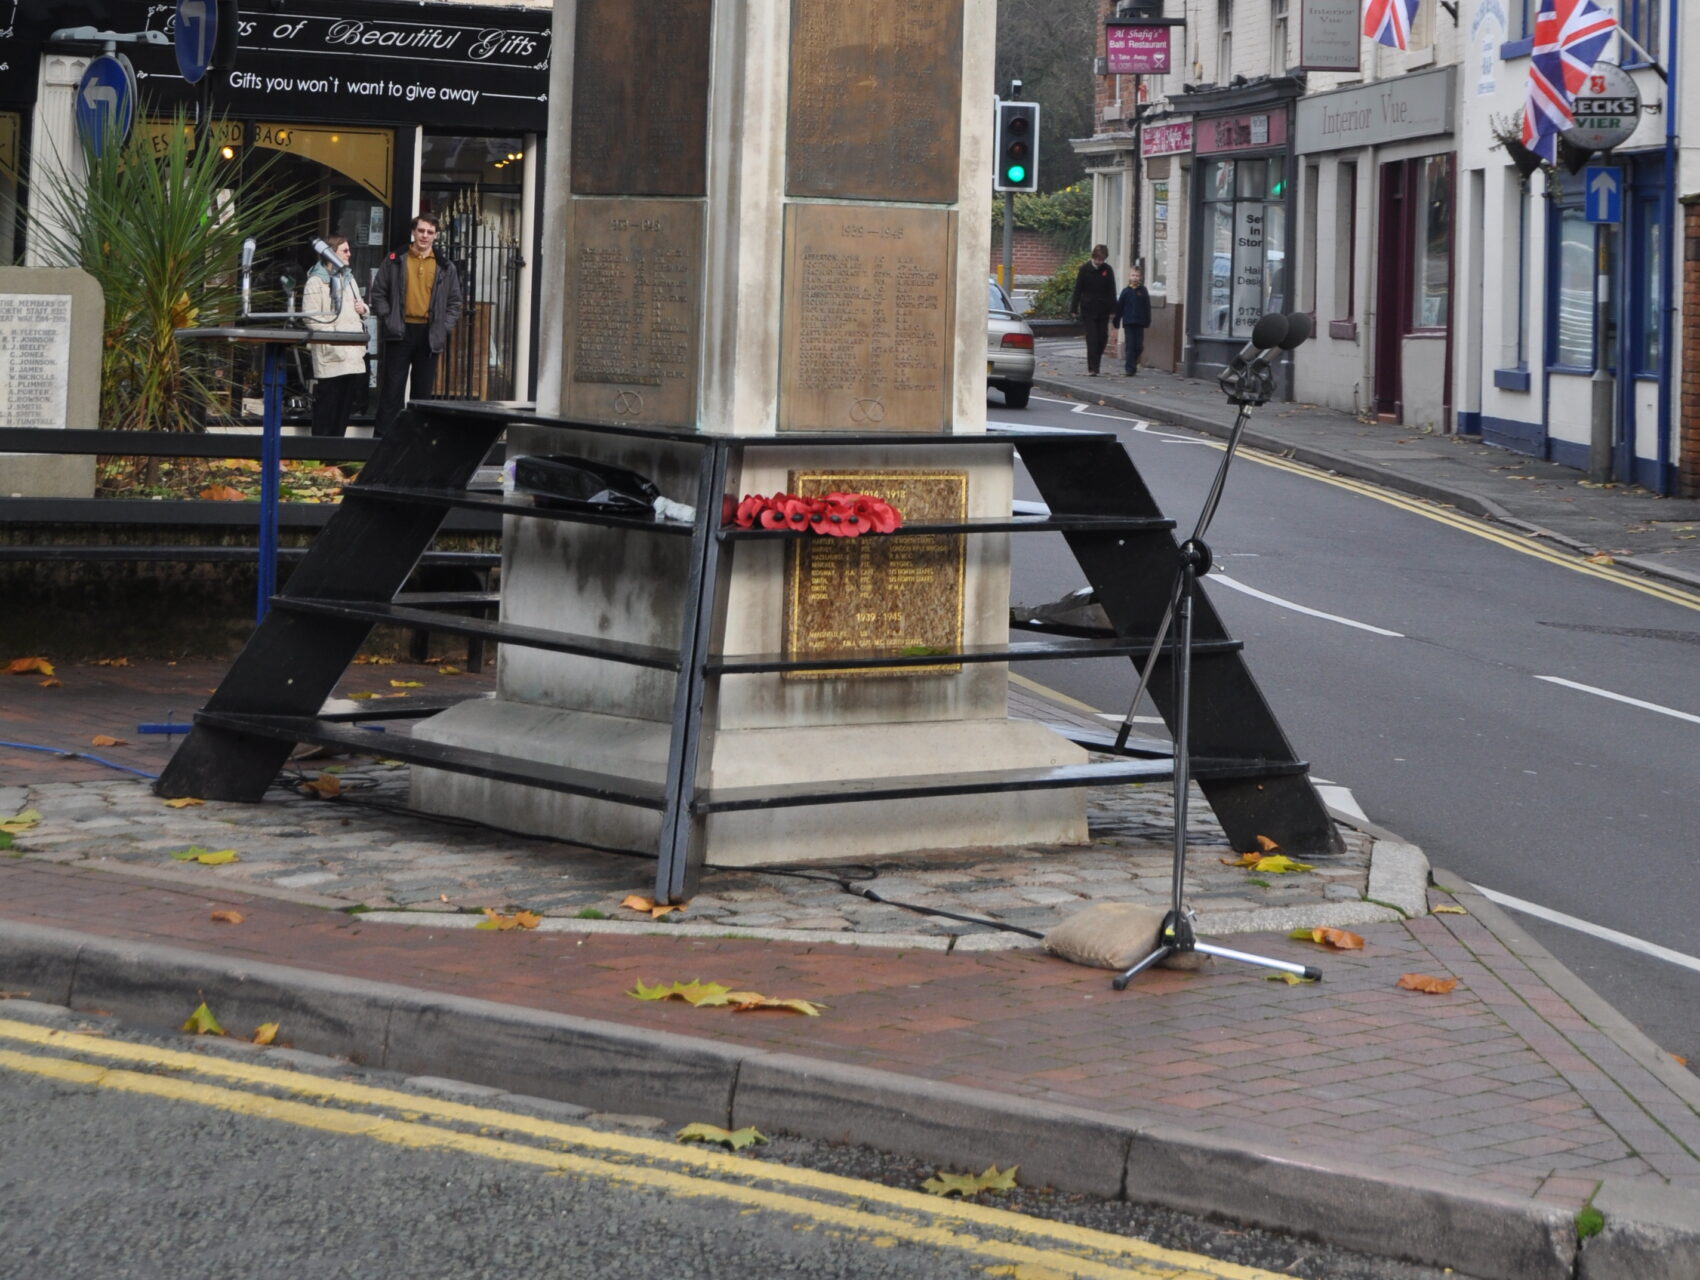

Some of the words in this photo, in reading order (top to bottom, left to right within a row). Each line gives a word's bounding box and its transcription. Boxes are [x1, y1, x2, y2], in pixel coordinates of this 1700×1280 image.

[273, 20, 308, 39] of
[325, 19, 462, 49] Beautiful
[468, 27, 537, 61] Gifts
[1128, 40, 1167, 49] Restaurant
[229, 71, 262, 90] Gifts
[266, 76, 293, 93] you
[347, 80, 384, 96] want
[388, 83, 403, 97] to
[406, 82, 436, 101] give
[439, 86, 479, 105] away
[1321, 100, 1372, 135] Interior
[1381, 93, 1408, 123] Vue
[1575, 117, 1622, 129] VIER
[254, 125, 294, 147] BAGS
